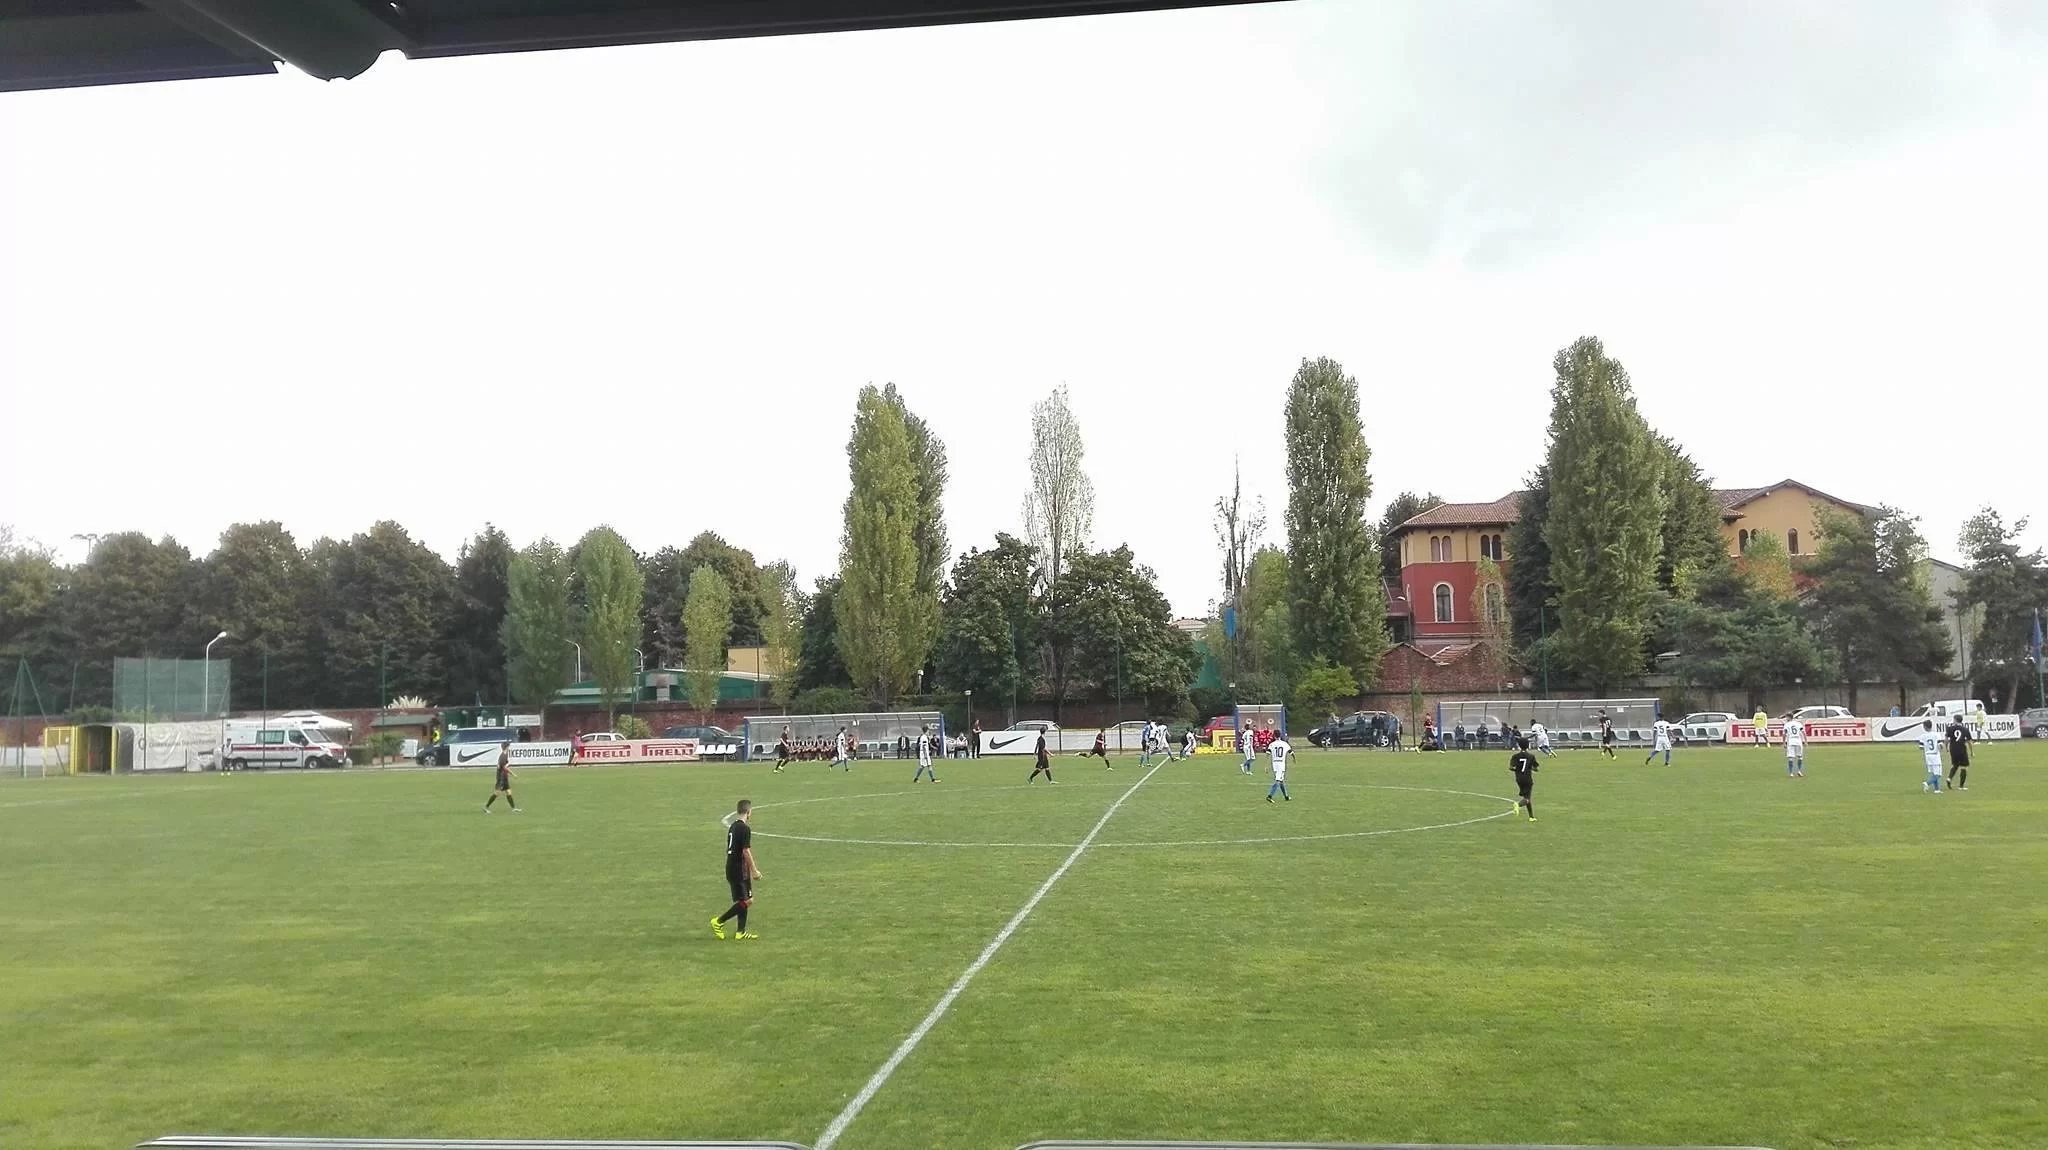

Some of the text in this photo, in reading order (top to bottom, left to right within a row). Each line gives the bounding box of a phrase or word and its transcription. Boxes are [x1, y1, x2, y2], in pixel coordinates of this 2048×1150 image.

[1791, 725, 1798, 735] 6
[1805, 723, 1866, 737] PIRELLI
[1954, 730, 1962, 742] 9
[580, 744, 631, 758] PIRELLI
[642, 743, 694, 757] PIRELLI
[1926, 739, 1935, 751] 3
[508, 748, 569, 759] IKEFOOTBALL.COM
[1274, 747, 1284, 758] 10
[1519, 758, 1527, 773] 7
